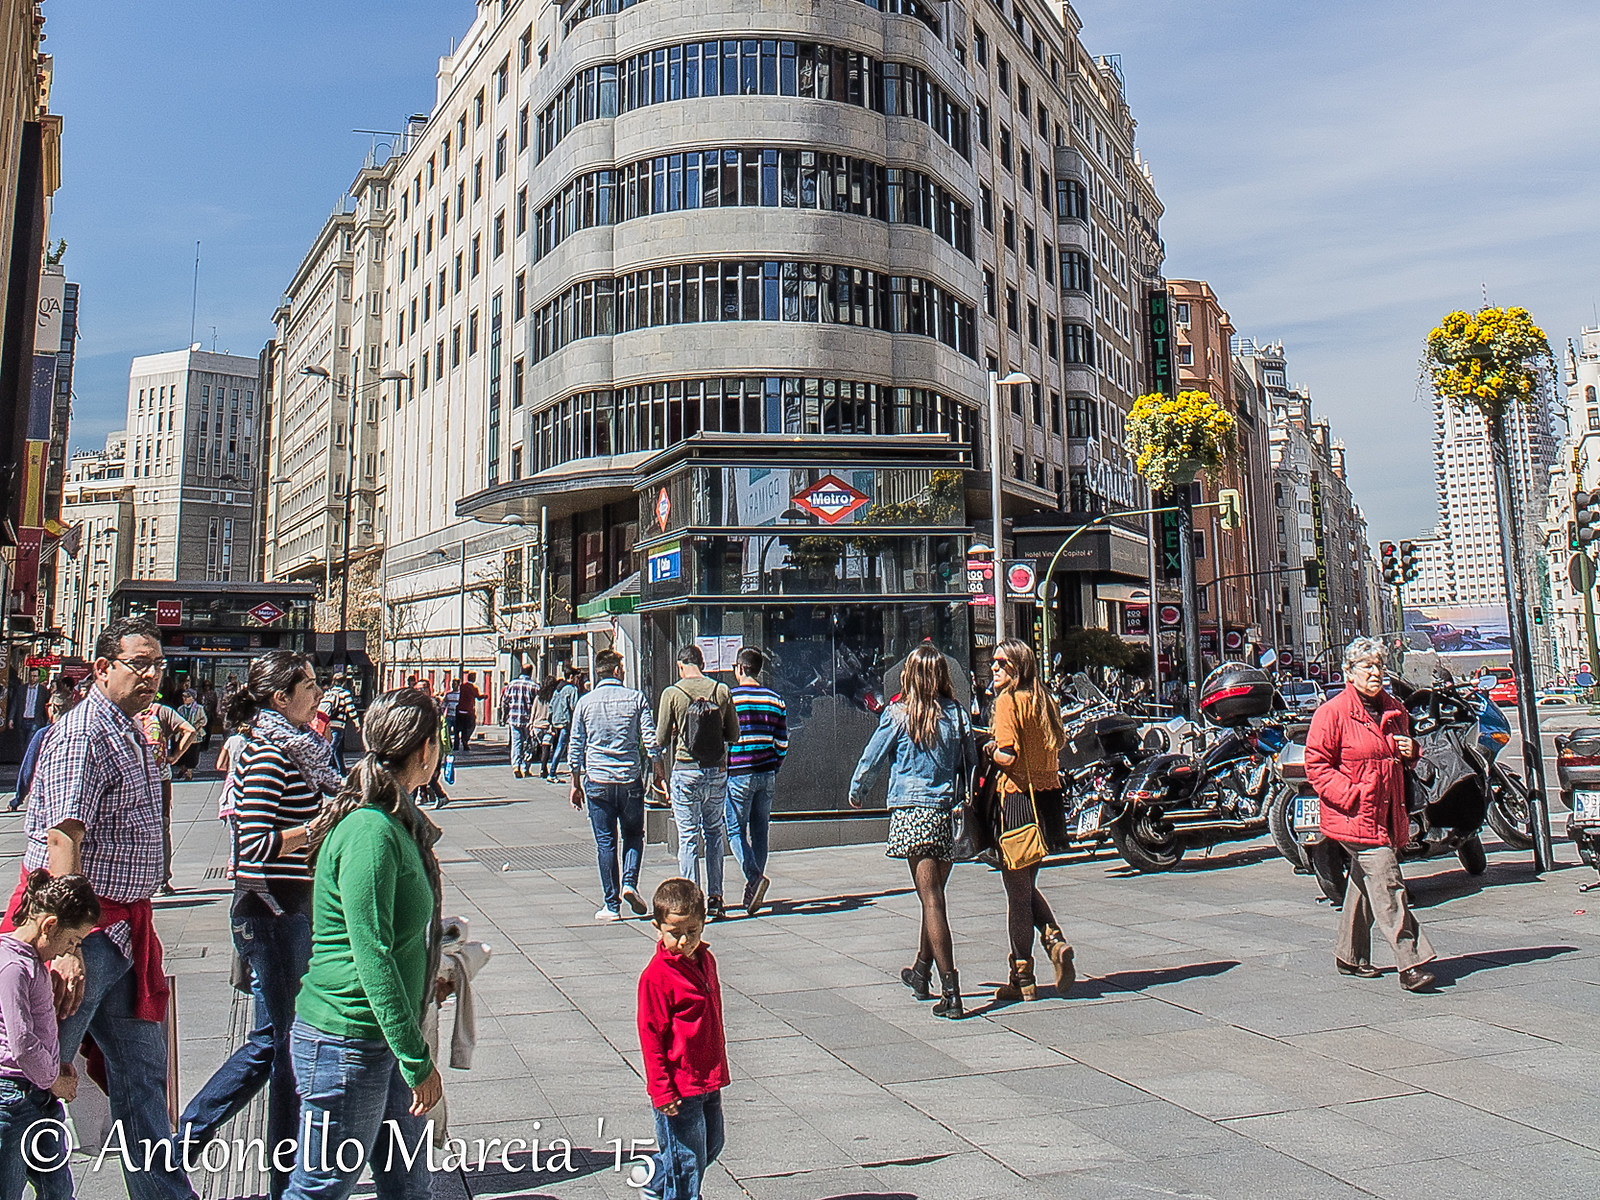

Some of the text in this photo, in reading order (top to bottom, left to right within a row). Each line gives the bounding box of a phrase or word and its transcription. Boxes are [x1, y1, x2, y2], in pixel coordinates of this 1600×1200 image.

[1152, 298, 1180, 569] HOTEL REX
[812, 493, 849, 505] Metro
[1311, 482, 1323, 539] HOTEL
[1024, 551, 1041, 559] Hotel
[1063, 549, 1086, 559] Capitol
